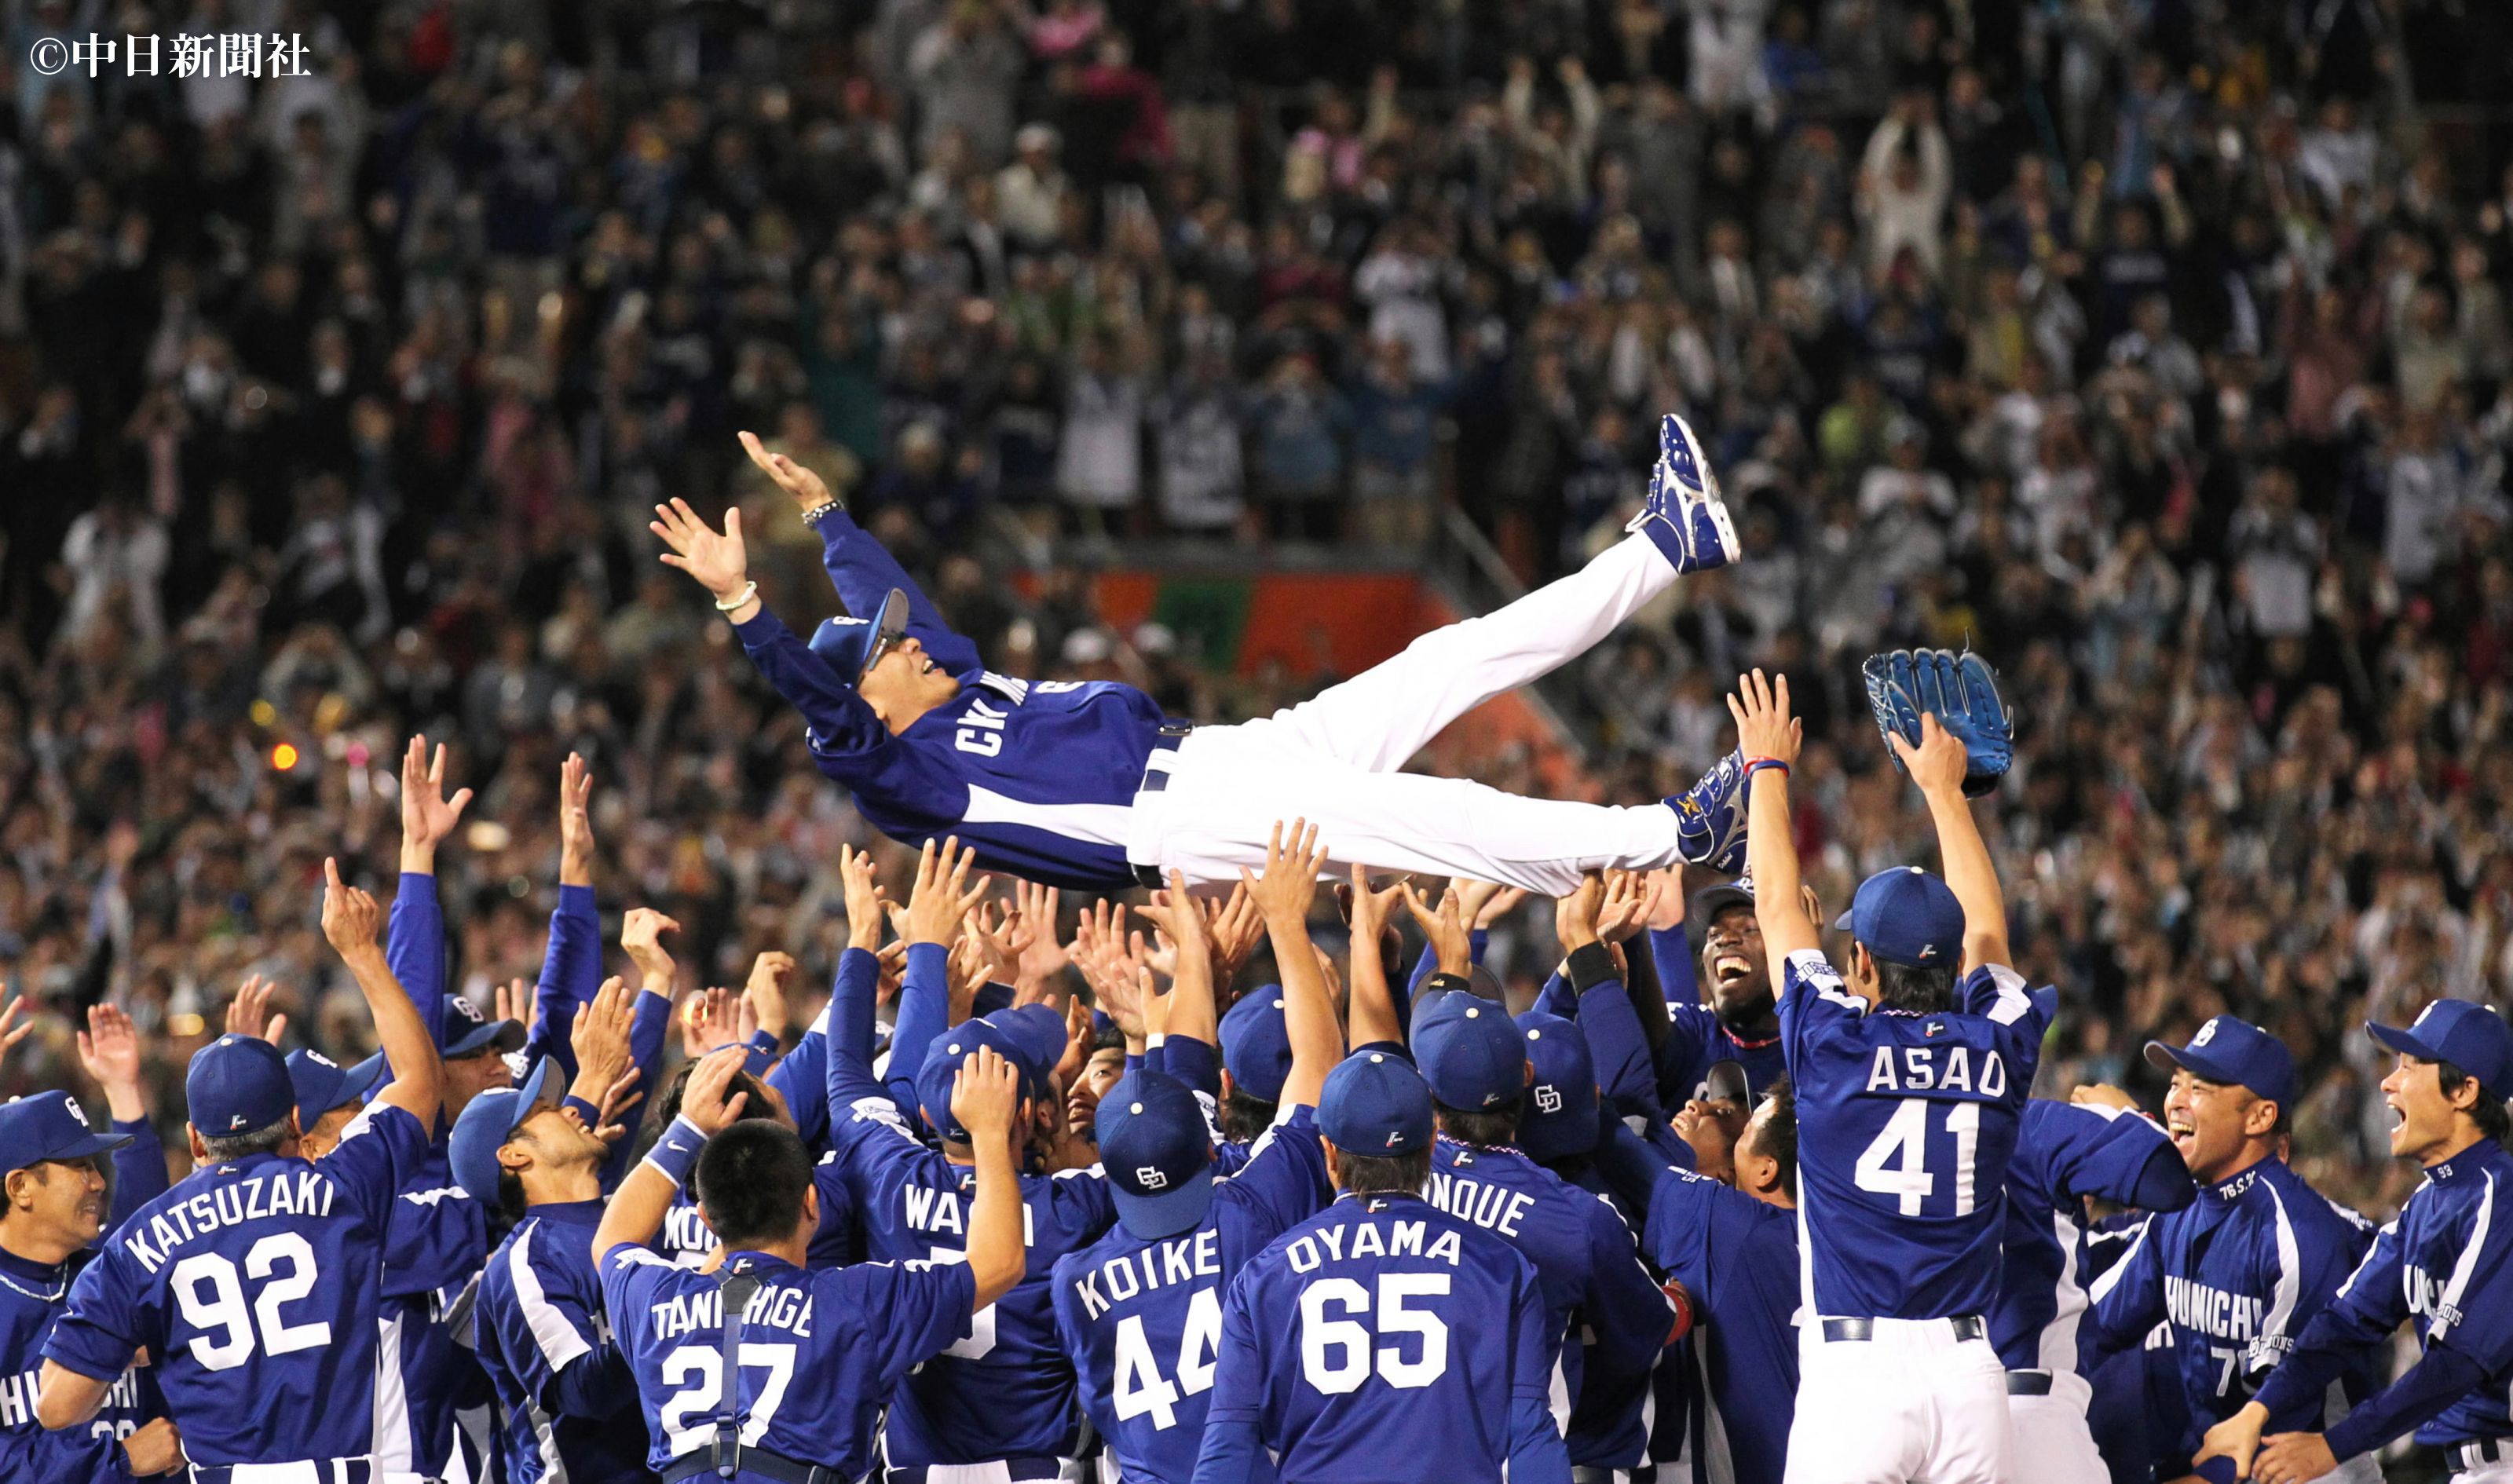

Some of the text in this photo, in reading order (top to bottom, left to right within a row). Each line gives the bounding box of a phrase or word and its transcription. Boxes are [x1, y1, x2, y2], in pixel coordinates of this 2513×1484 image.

[1866, 1046, 2006, 1098] ASAO
[1854, 1098, 1980, 1217] 41
[125, 1171, 334, 1274] KATSUZAKI
[1075, 1228, 1222, 1321] KOIKE
[1286, 1220, 1461, 1274] OYAMA
[170, 1231, 331, 1372] 92
[650, 1284, 814, 1341] TANIHIGE
[1300, 1273, 1451, 1394] 65
[661, 1343, 797, 1457] 27
[1112, 1285, 1222, 1431] 44
